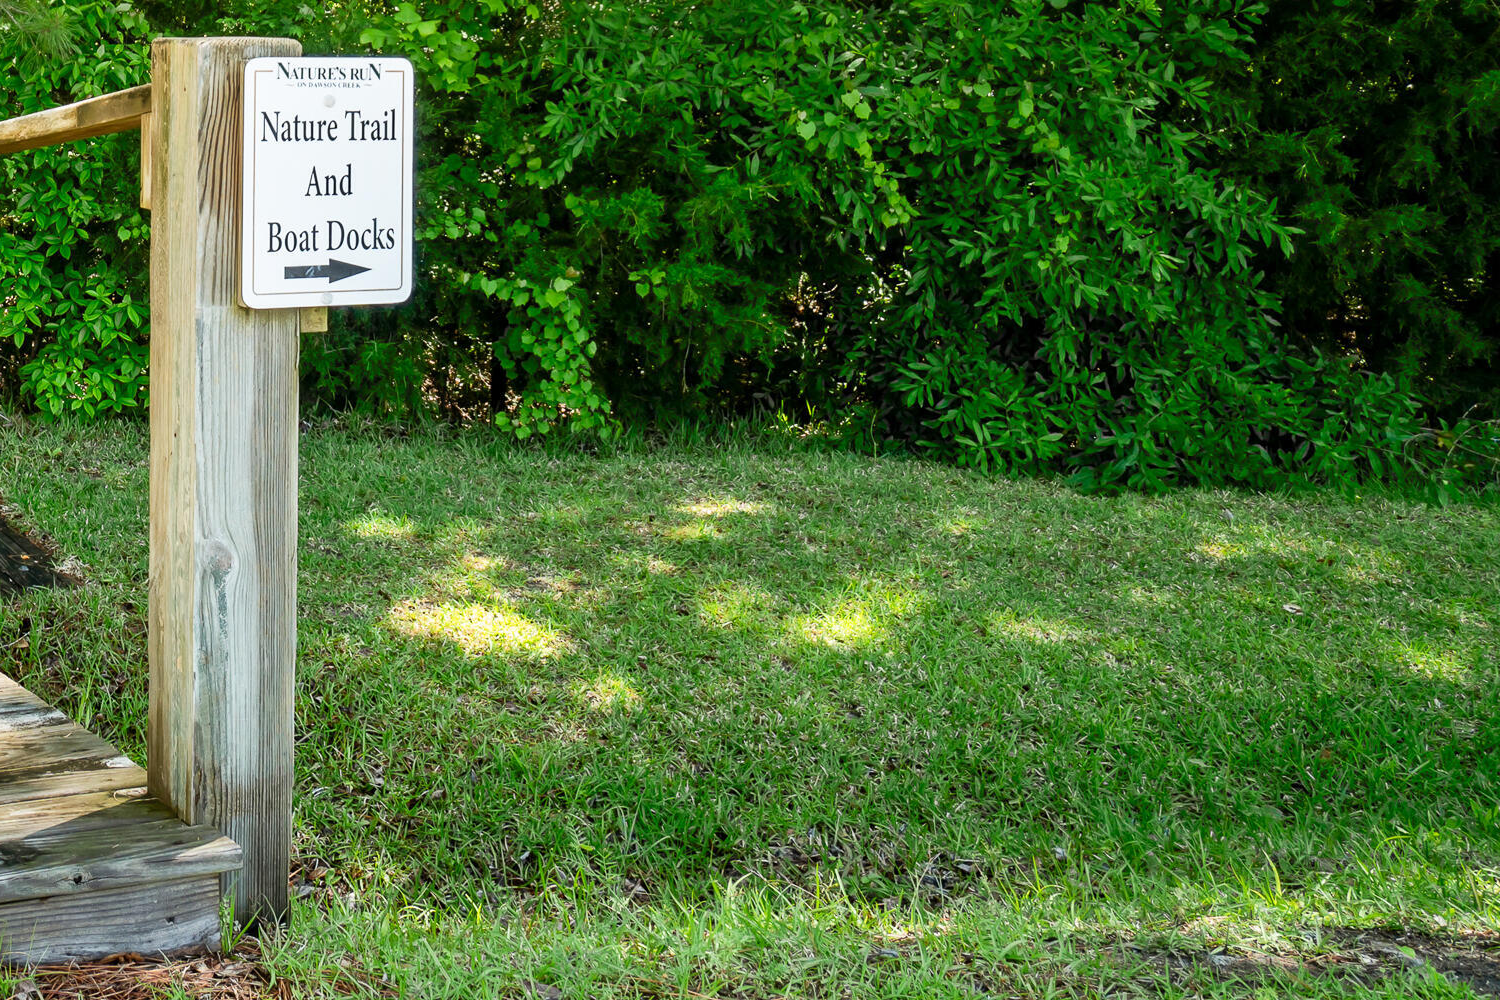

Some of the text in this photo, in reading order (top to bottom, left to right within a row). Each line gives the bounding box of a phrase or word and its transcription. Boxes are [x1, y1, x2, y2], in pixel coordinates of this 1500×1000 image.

[277, 62, 347, 81] NATURE'S
[260, 108, 397, 142] Nature Trail
[304, 163, 353, 196] And
[267, 217, 395, 253] Boat Docks
